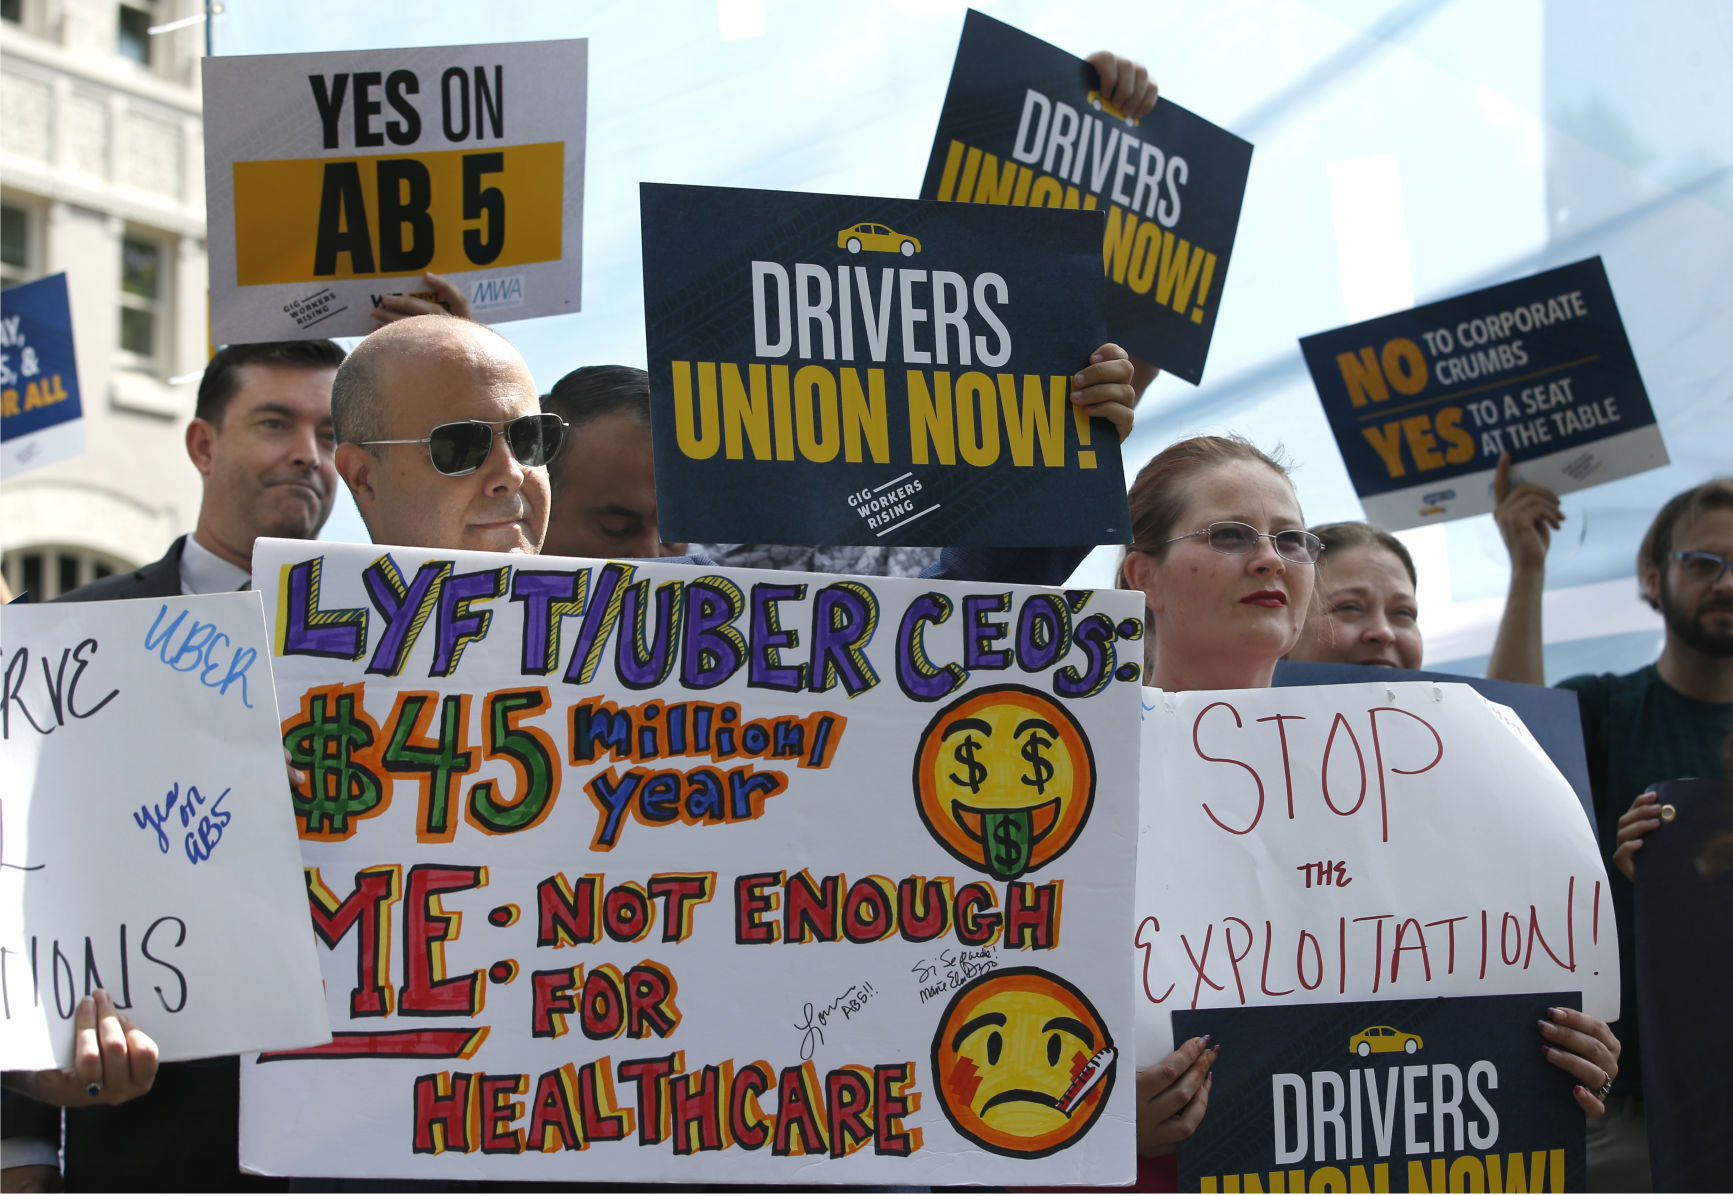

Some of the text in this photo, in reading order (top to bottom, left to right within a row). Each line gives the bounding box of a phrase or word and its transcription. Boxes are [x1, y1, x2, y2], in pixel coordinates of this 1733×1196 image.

[308, 64, 503, 149] YES ON
[1012, 88, 1188, 228] DRIVERS
[313, 152, 505, 276] AB 5
[283, 300, 301, 312] GIG
[289, 293, 336, 318] WORKERS
[296, 305, 329, 325] RISING
[472, 278, 521, 304] MWA
[752, 260, 1011, 367] DRIVERS
[1103, 205, 1217, 325] NOW!
[24, 373, 68, 412] ALL
[1336, 291, 1587, 408] NO TO CORPORATE
[1436, 340, 1529, 386] CRUMBS
[672, 360, 1097, 469] UNION NOW!
[1362, 378, 1574, 479] YES TO A SEAT
[1480, 397, 1621, 456] AT THE TABLE
[847, 488, 872, 507] GIG
[857, 480, 922, 518] WORKERS
[867, 500, 914, 529] RISING
[144, 604, 258, 708] UBER
[275, 553, 881, 699] LYFT/UBER
[0, 638, 119, 739] RVE
[282, 682, 562, 843] $45
[583, 764, 789, 852] year
[1193, 701, 1443, 842] STOP
[1297, 860, 1353, 888] THE
[304, 864, 1064, 1019] ME: NOT ENOUGH
[1134, 876, 1601, 1010] EXPLOITATION!
[532, 958, 683, 1041] FOR
[412, 1050, 924, 1159] HEALTHCARE
[1271, 1059, 1500, 1165] DRIVERS
